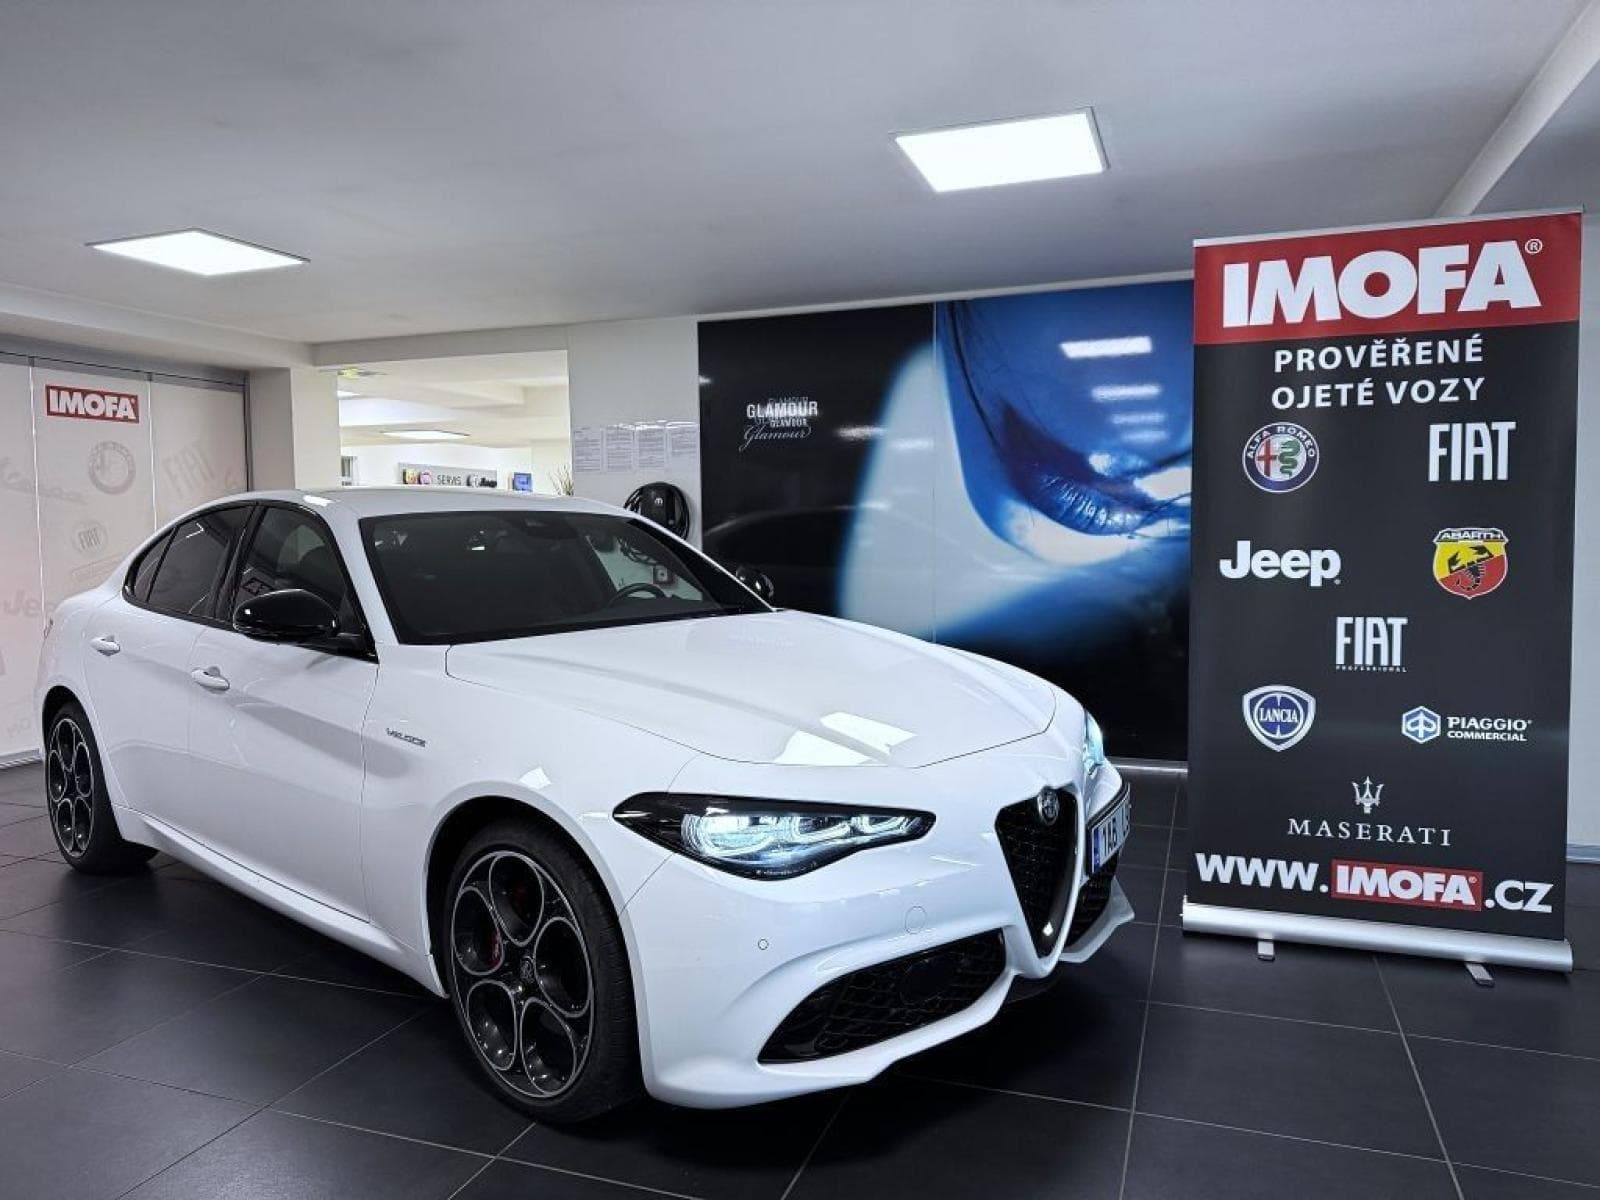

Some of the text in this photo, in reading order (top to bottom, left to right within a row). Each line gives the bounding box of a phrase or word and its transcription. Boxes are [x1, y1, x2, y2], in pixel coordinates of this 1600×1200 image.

[1274, 334, 1484, 373] PROVĚŘENÉ
[49, 388, 137, 420] IMOFA
[1271, 377, 1486, 409] OJETÉ VOZY
[746, 401, 818, 419] GLAMOUR
[738, 424, 812, 452] Glamour
[1246, 426, 1316, 459] ALFA ROMEO
[1428, 421, 1516, 482] FIAT
[1219, 540, 1341, 587] Jeep
[1336, 616, 1409, 667] FIAT
[1259, 707, 1298, 723] LANCIA
[1446, 716, 1528, 731] PIAGGIO
[1446, 730, 1528, 741] COMMERCIAL
[1287, 818, 1452, 846] MASERATI
